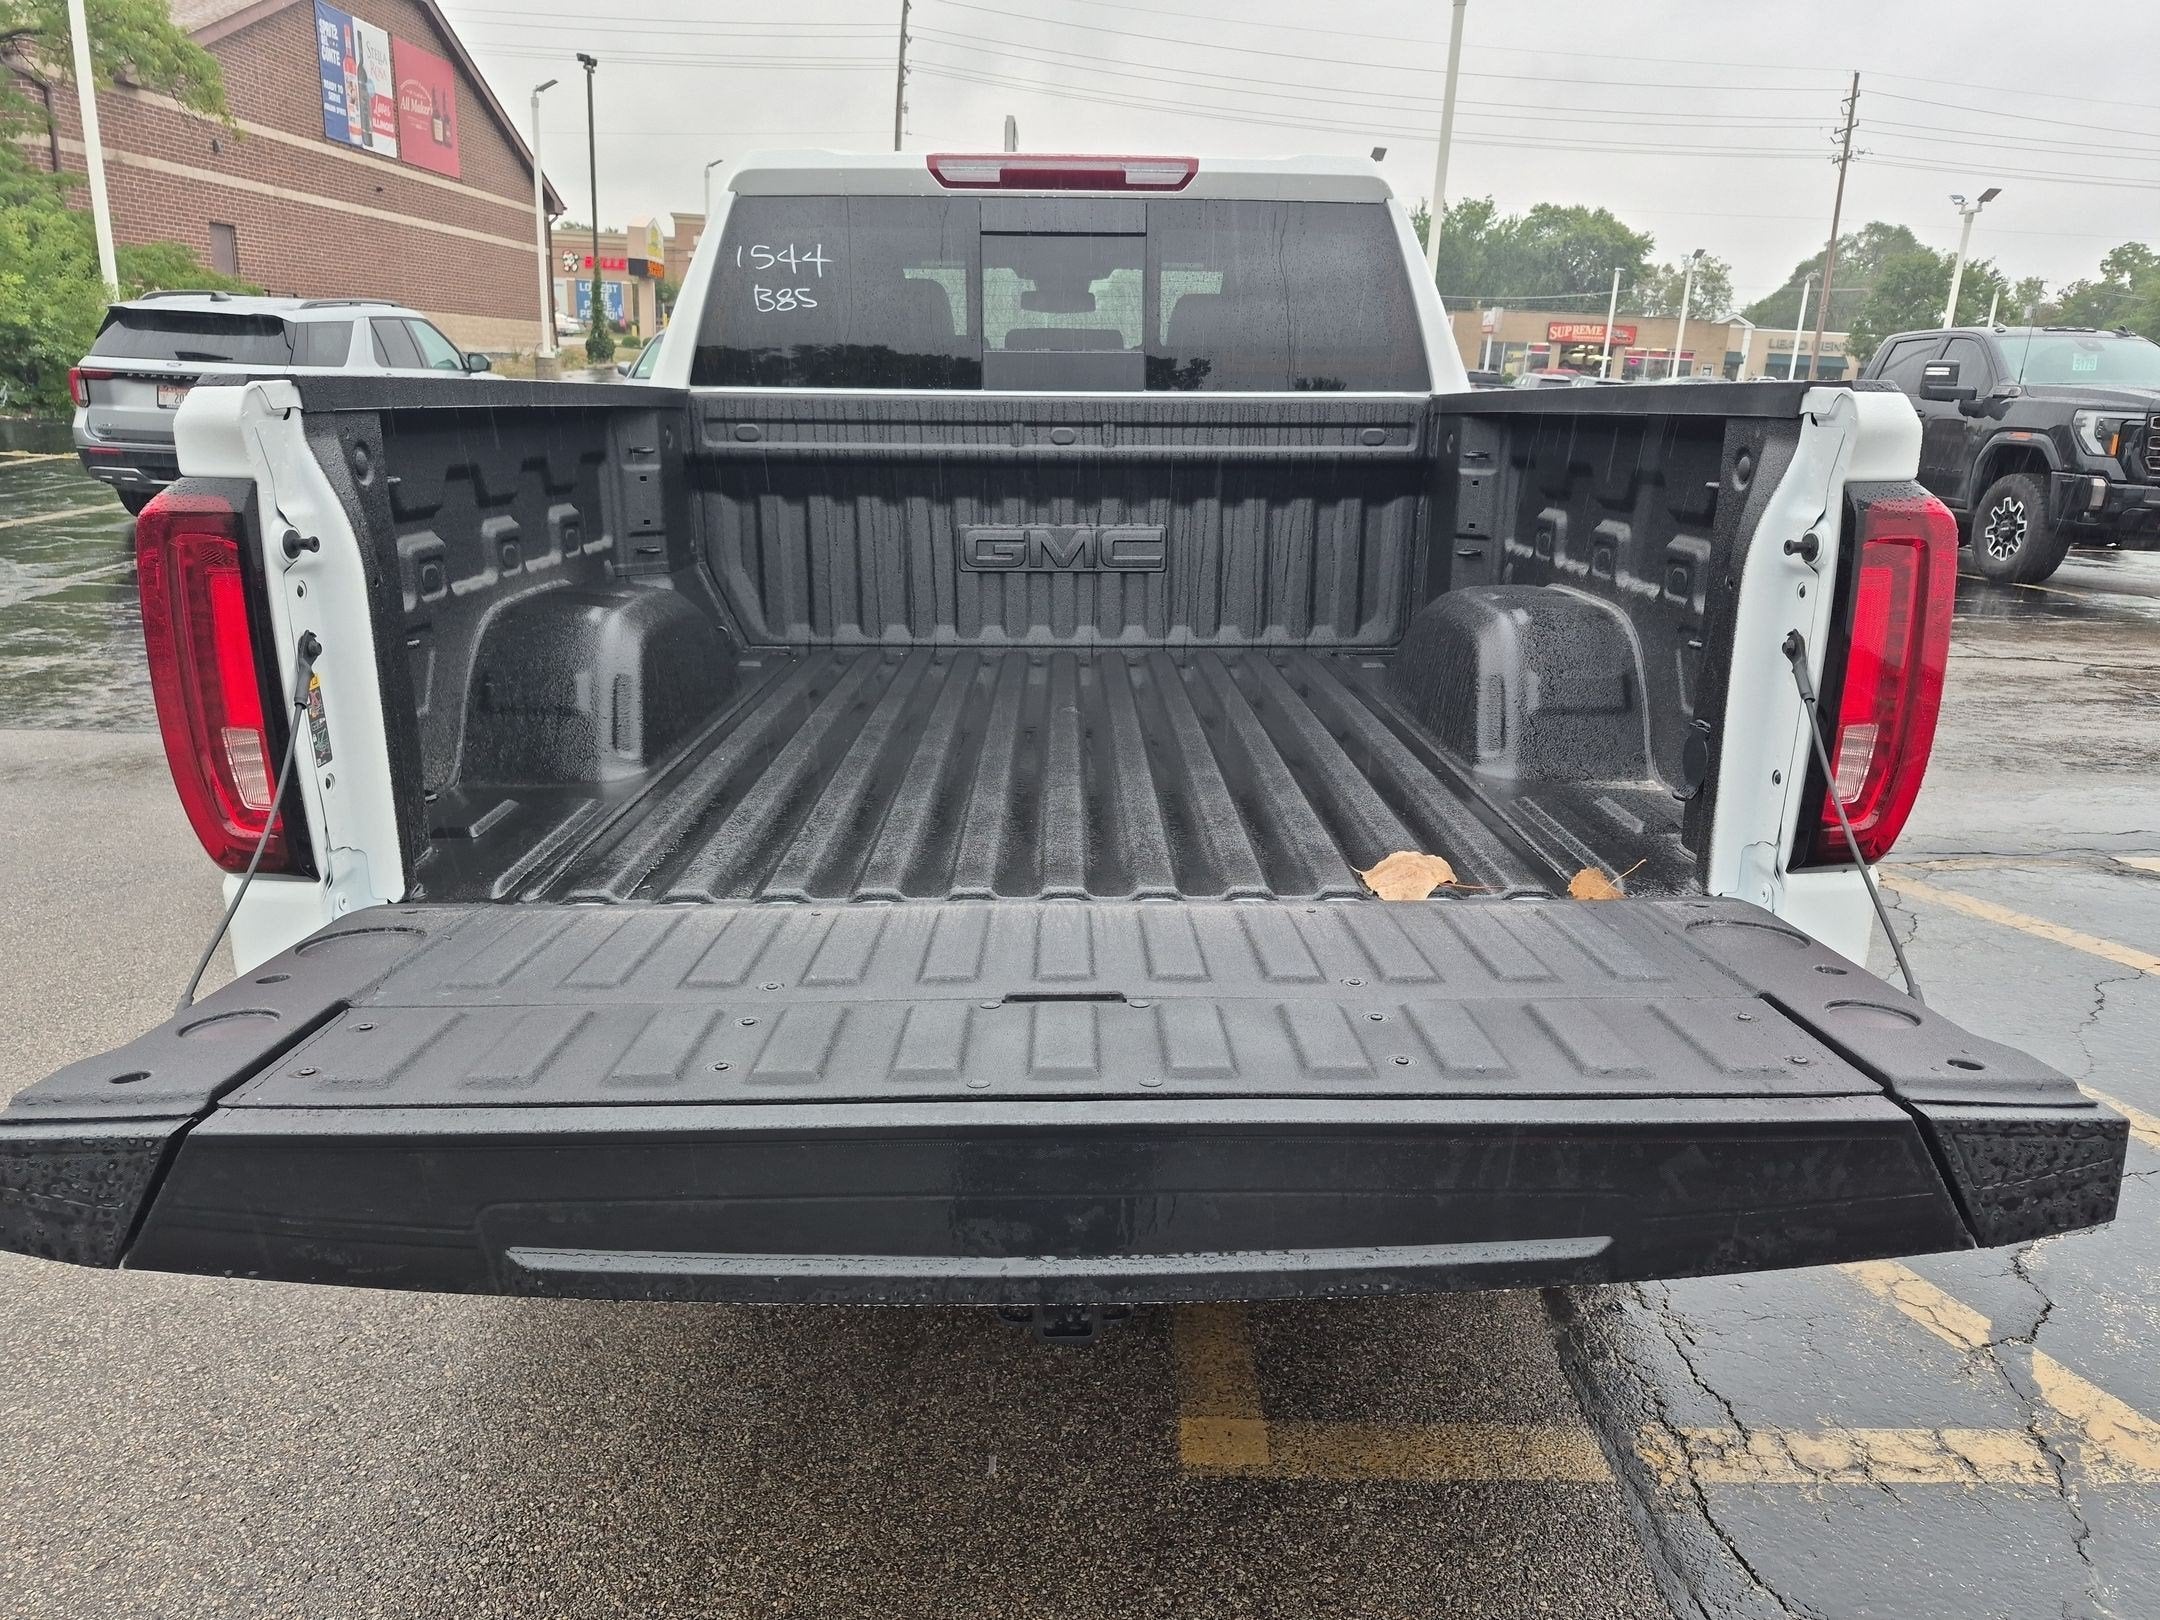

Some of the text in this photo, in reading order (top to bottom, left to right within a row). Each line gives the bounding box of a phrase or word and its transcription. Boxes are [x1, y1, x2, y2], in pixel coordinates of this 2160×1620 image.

[366, 41, 388, 65] STELLA
[585, 257, 626, 271] BLLE
[737, 243, 834, 278] 1544
[580, 283, 618, 293] LOEST
[753, 284, 818, 312] B85
[1549, 325, 1604, 340] SUPREME
[964, 529, 1163, 568] GMC
